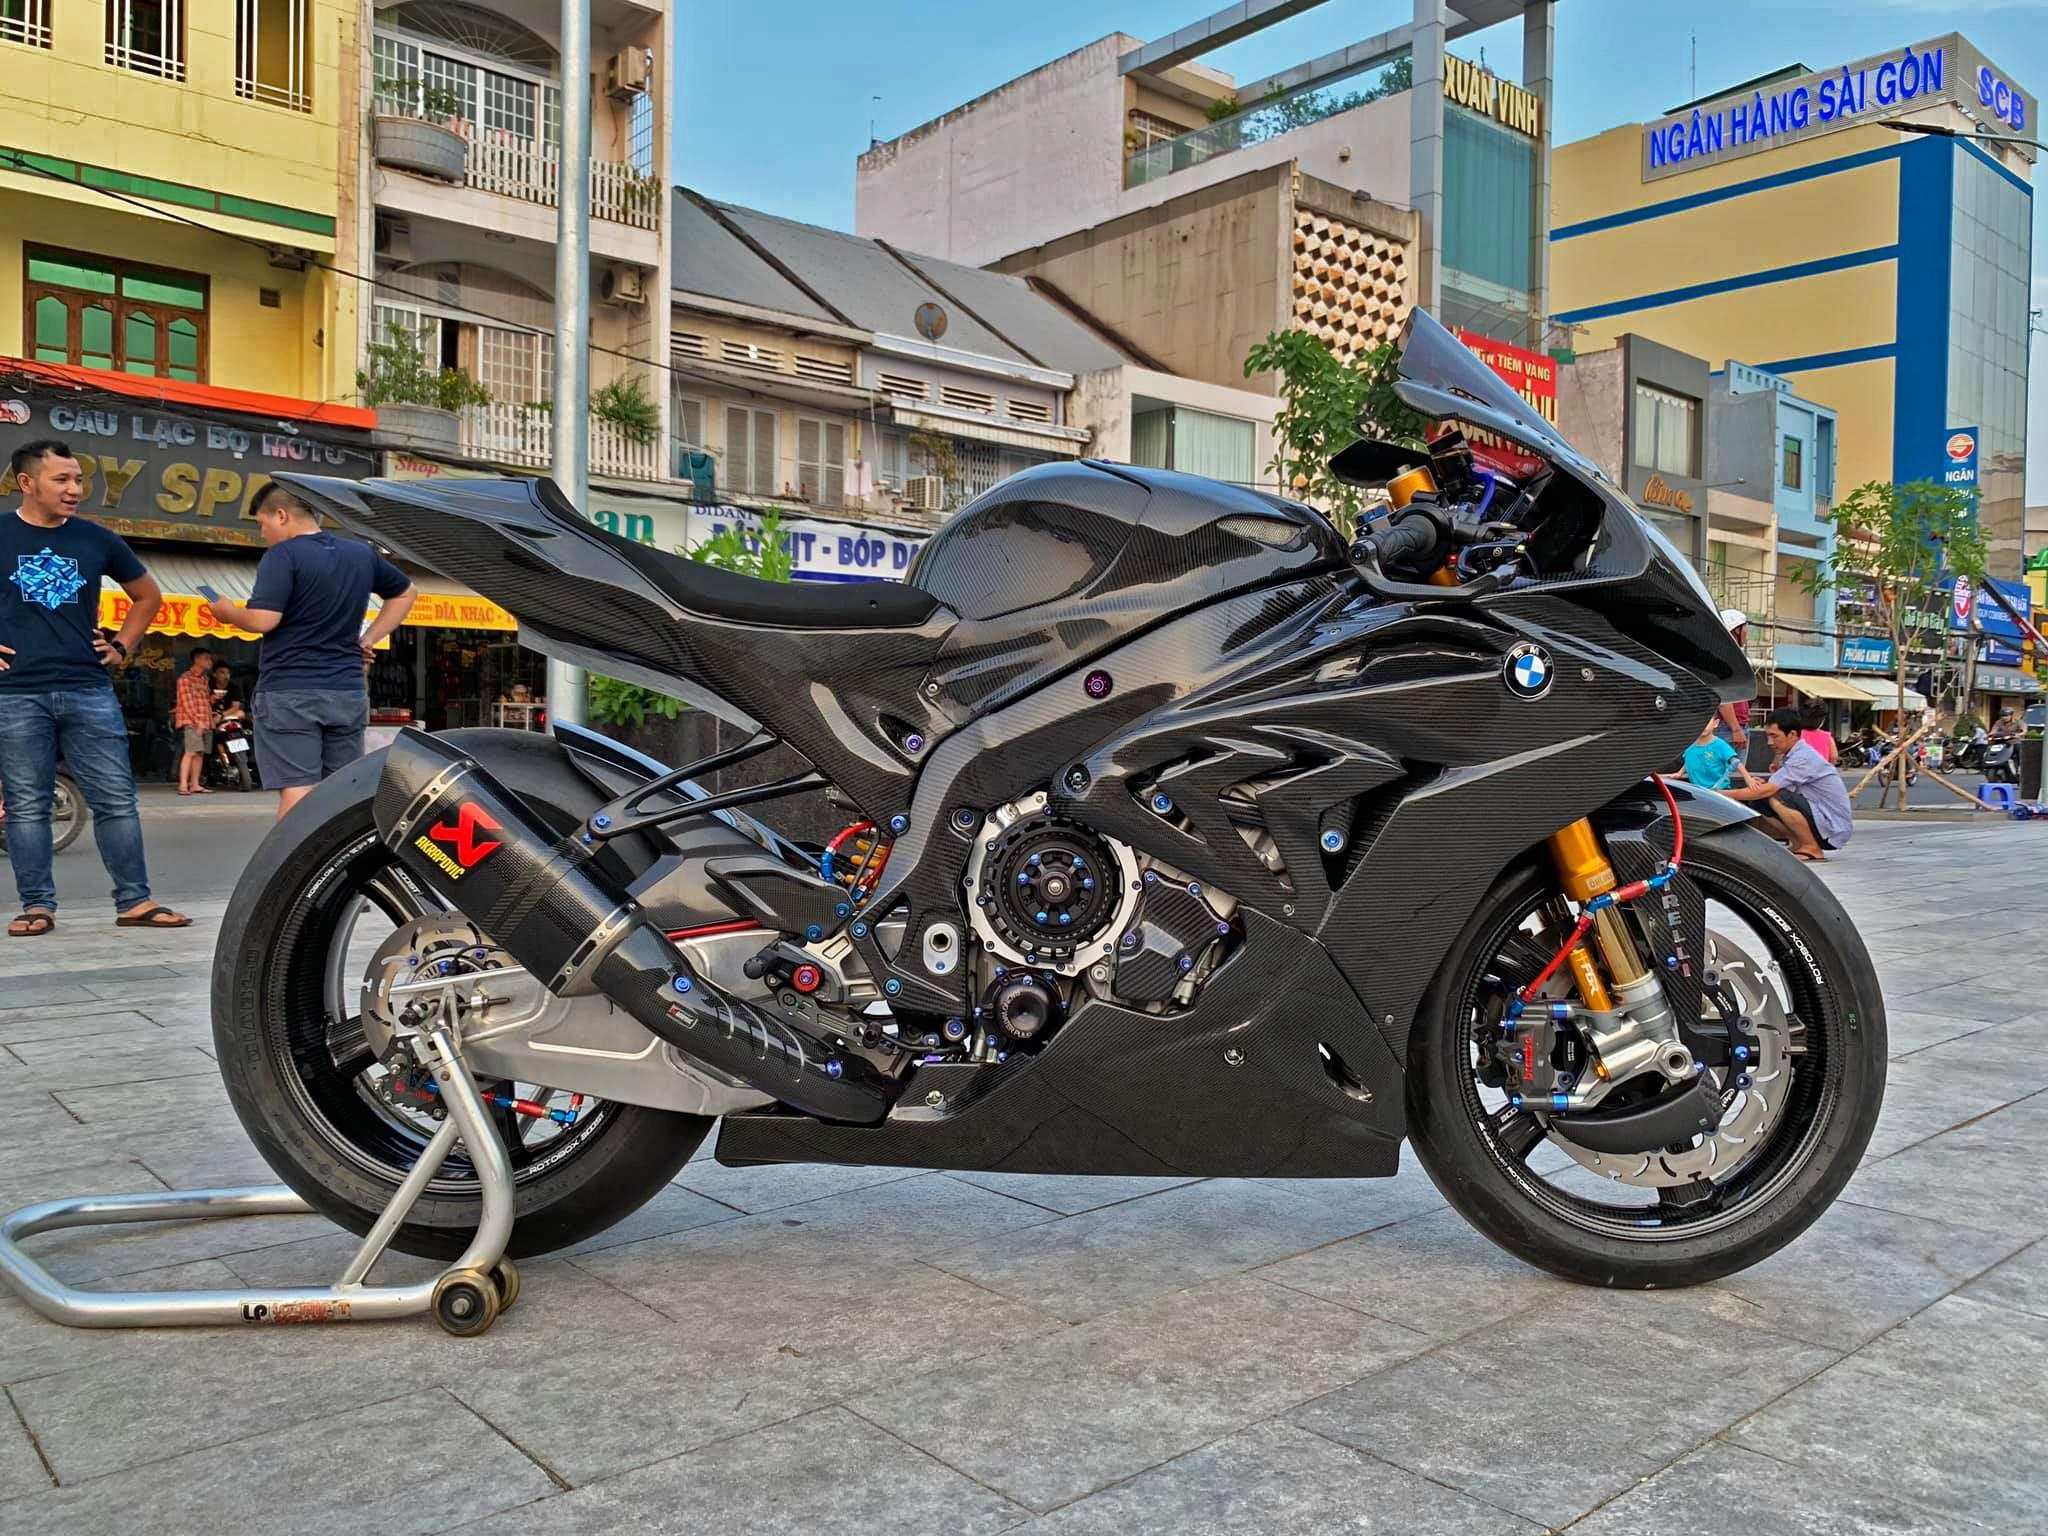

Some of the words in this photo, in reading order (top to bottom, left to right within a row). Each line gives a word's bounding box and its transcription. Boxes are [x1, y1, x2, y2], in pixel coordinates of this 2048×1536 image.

[1651, 110, 1723, 168] NGÂN
[1731, 91, 1809, 147] HÀNG
[1819, 65, 1866, 123] SÀI
[1876, 47, 1944, 105] GÒN
[1977, 66, 2025, 131] SCB
[1497, 352, 1522, 374] TIỆM
[1524, 359, 1551, 382] VÀNG
[131, 415, 196, 449] LẠC
[394, 455, 439, 478] Shop
[1945, 467, 1975, 482] NGÂN
[837, 531, 886, 567] BÓP
[459, 604, 495, 625] NHẠC
[1511, 645, 1553, 668] BMW
[414, 835, 466, 880] AKRAPOVIC
[1761, 905, 1793, 933] BOOST
[1789, 932, 1825, 985] ROTOBOX
[529, 1140, 579, 1175] ROTOBOX
[580, 1111, 606, 1142] BOOST
